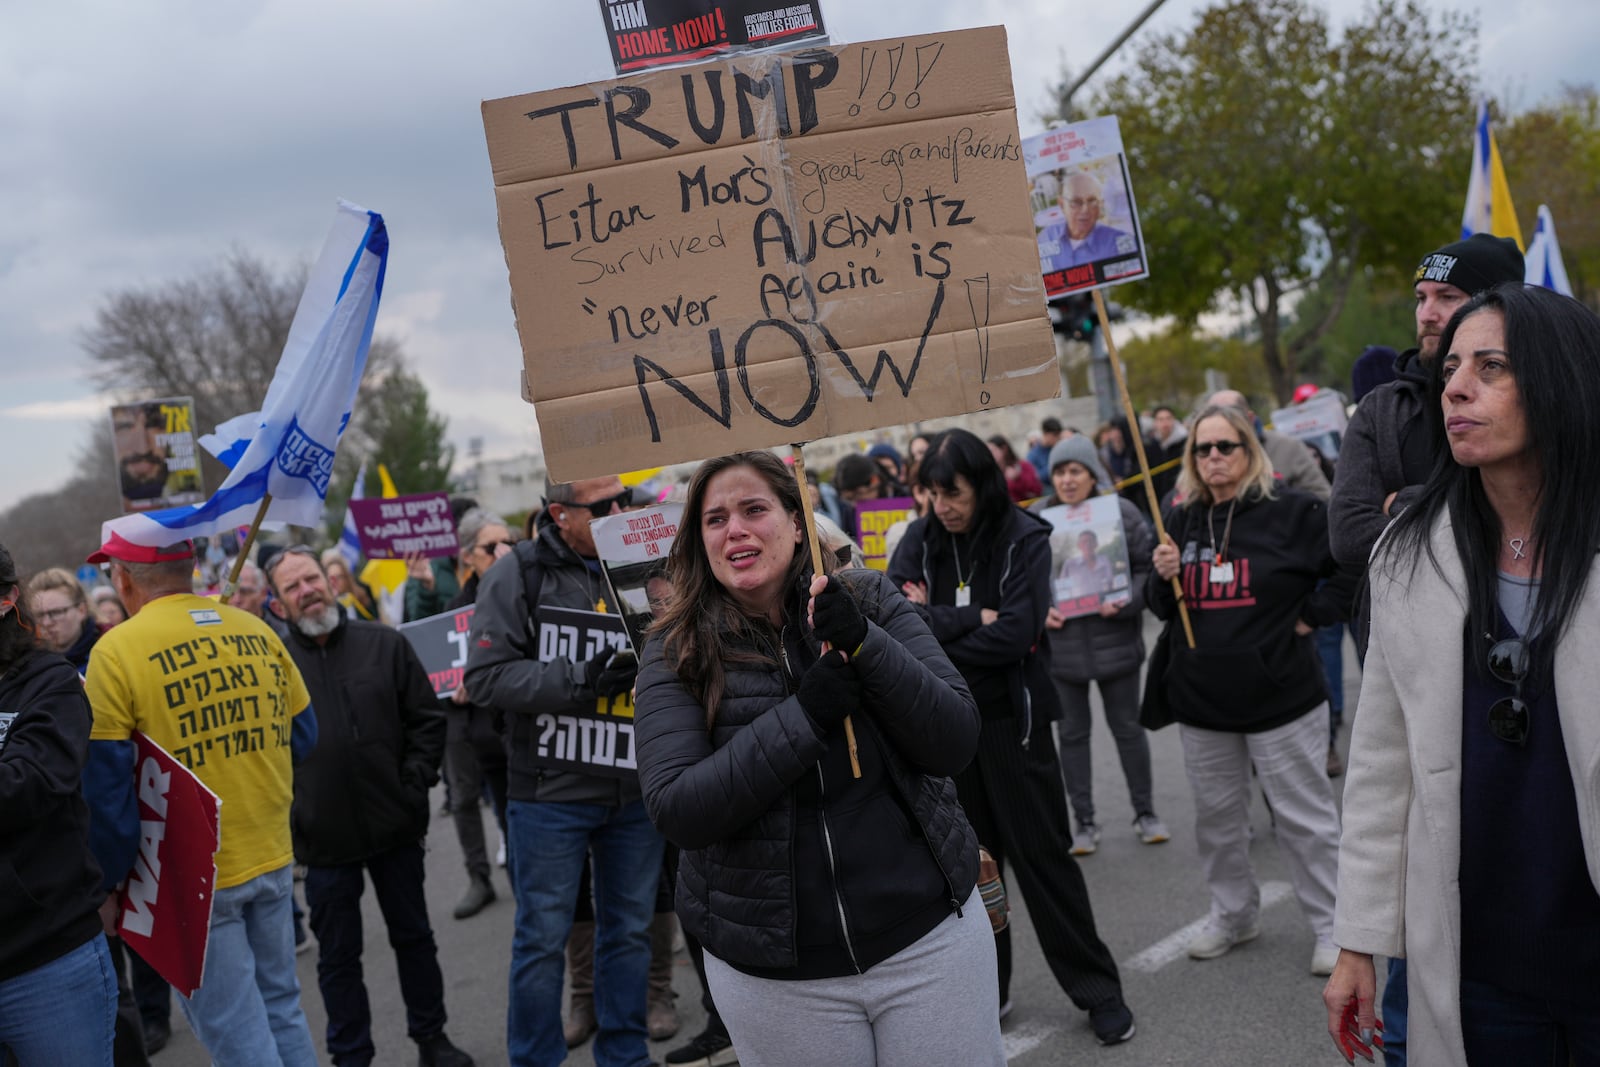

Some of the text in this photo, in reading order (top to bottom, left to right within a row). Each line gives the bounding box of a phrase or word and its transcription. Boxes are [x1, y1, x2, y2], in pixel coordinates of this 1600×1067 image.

[609, 1, 648, 31] HIM
[616, 7, 728, 59] HOME NOW!
[744, 4, 811, 25] HOSTAGES AND MISSING
[746, 13, 814, 38] FAMILIES FORUM
[535, 182, 656, 250] Eitan
[677, 154, 772, 213] Mor's
[570, 218, 726, 285] Survived
[911, 241, 952, 280] is
[1429, 254, 1458, 270] THEM
[160, 404, 191, 434] אל
[380, 497, 447, 519] לסיים את
[391, 533, 457, 553] המלחמה
[622, 532, 642, 546] MATAN
[645, 542, 660, 557] (24)
[148, 634, 283, 676] וחמי כיפור
[538, 622, 578, 664] הם
[163, 663, 260, 709] נאבקים
[178, 695, 260, 738] דמותה
[173, 727, 264, 769] המדינה
[535, 713, 638, 769] בעזה?
[121, 756, 171, 938] WAR
